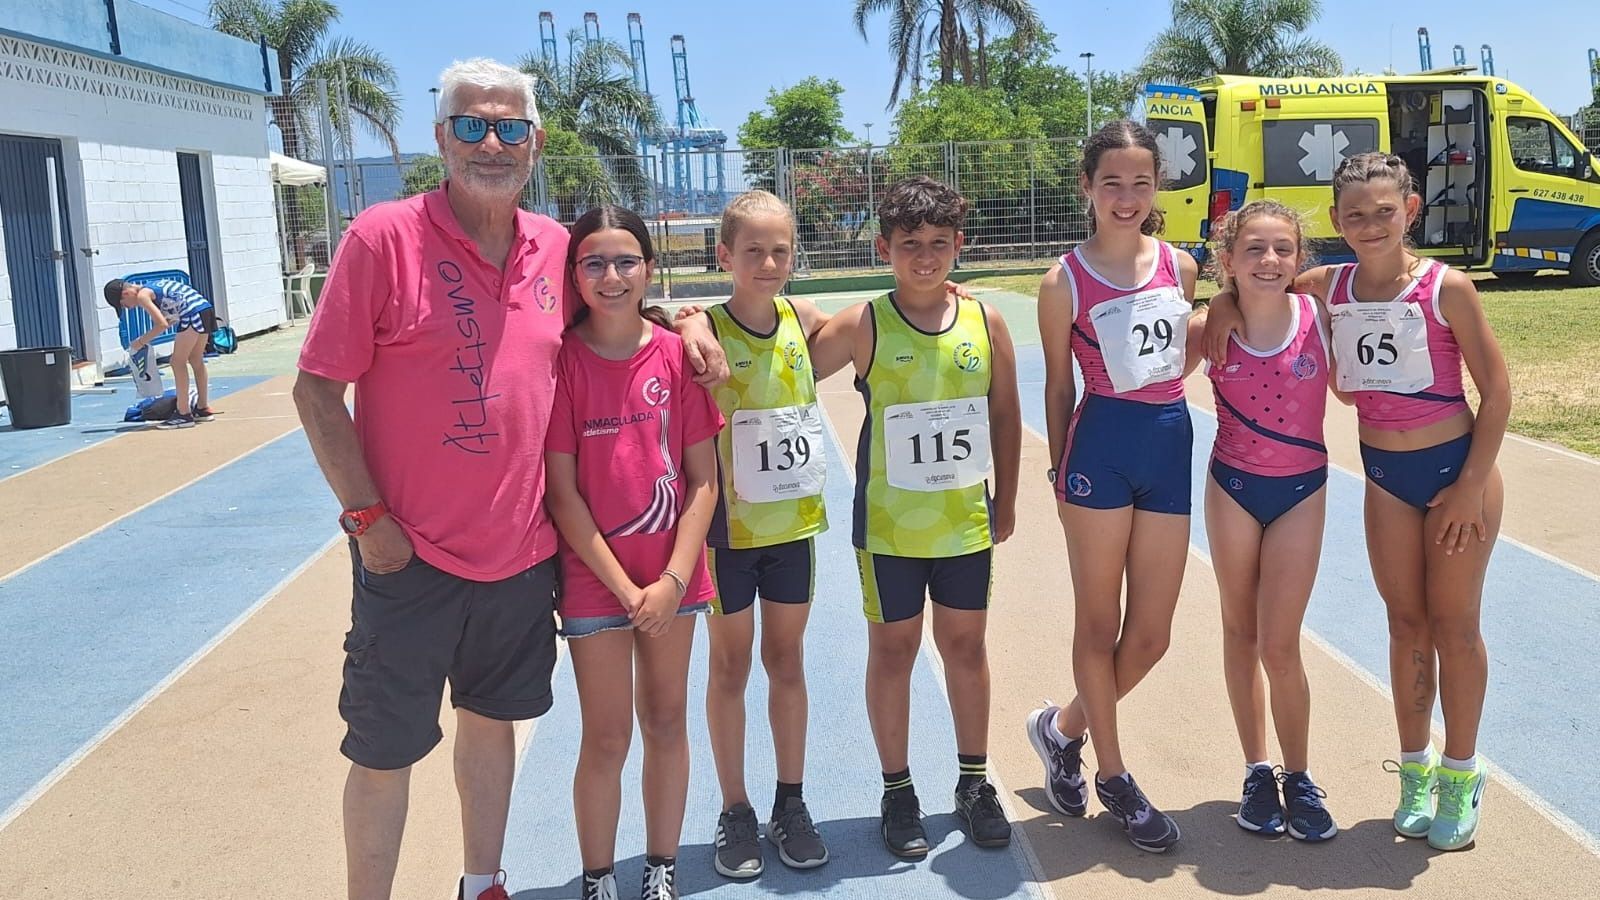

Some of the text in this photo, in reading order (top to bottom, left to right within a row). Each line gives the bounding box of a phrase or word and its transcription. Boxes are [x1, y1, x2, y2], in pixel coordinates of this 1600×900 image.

[1259, 82, 1378, 97] MBULANCIA
[1150, 103, 1193, 116] ANCIA
[1533, 188, 1549, 198] 627
[1132, 318, 1173, 357] 29
[1357, 332, 1398, 366] 65
[583, 411, 654, 429] NMACULADA
[755, 435, 810, 472] 139
[907, 429, 972, 464] 115
[1412, 649, 1426, 713] RAS
